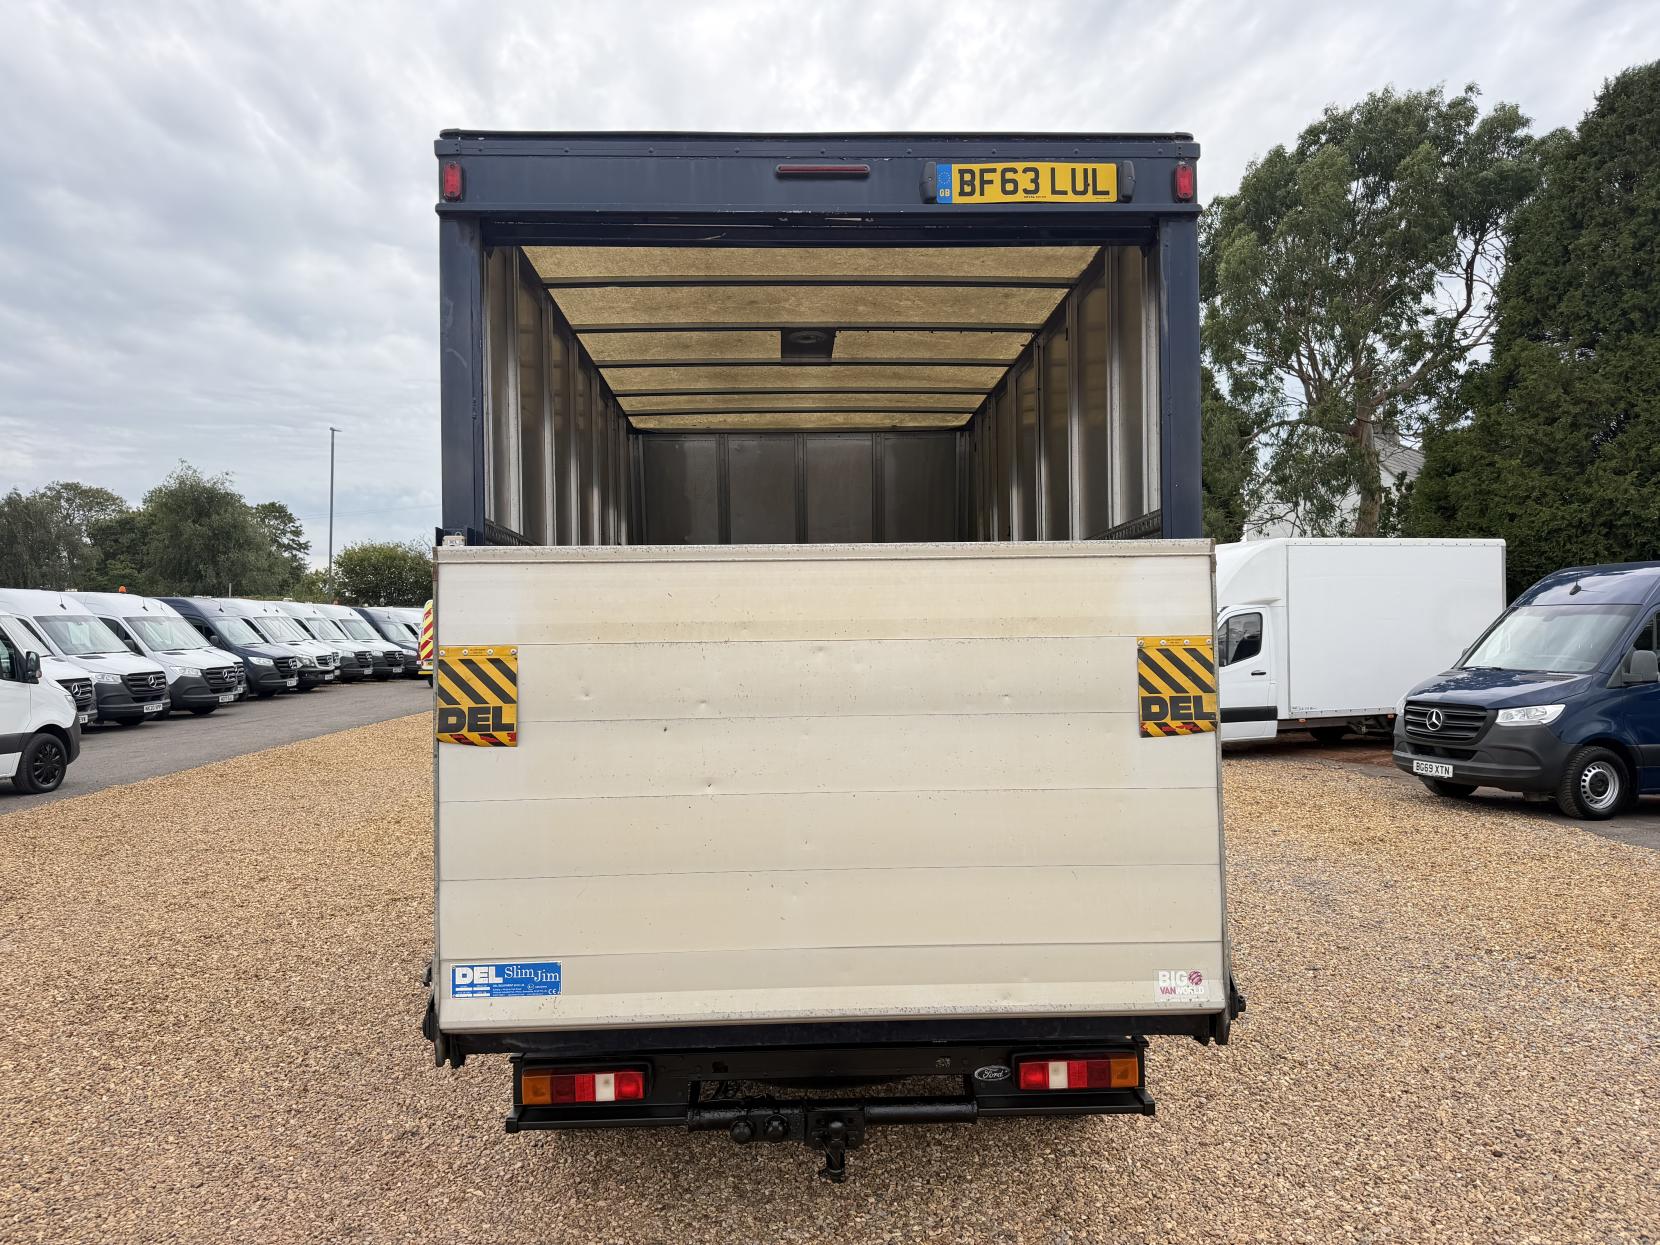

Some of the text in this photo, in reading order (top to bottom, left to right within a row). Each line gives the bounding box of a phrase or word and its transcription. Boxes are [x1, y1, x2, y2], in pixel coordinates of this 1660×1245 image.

[958, 167, 1110, 197] BF63 LUL
[939, 188, 950, 197] GB
[1140, 695, 1217, 721] DEL
[437, 706, 515, 733] DEL
[1416, 762, 1450, 775] BG69 XTN
[455, 965, 560, 984] DEL Slim Jim
[1158, 970, 1187, 986] BIG
[983, 1069, 1003, 1079] Ford
